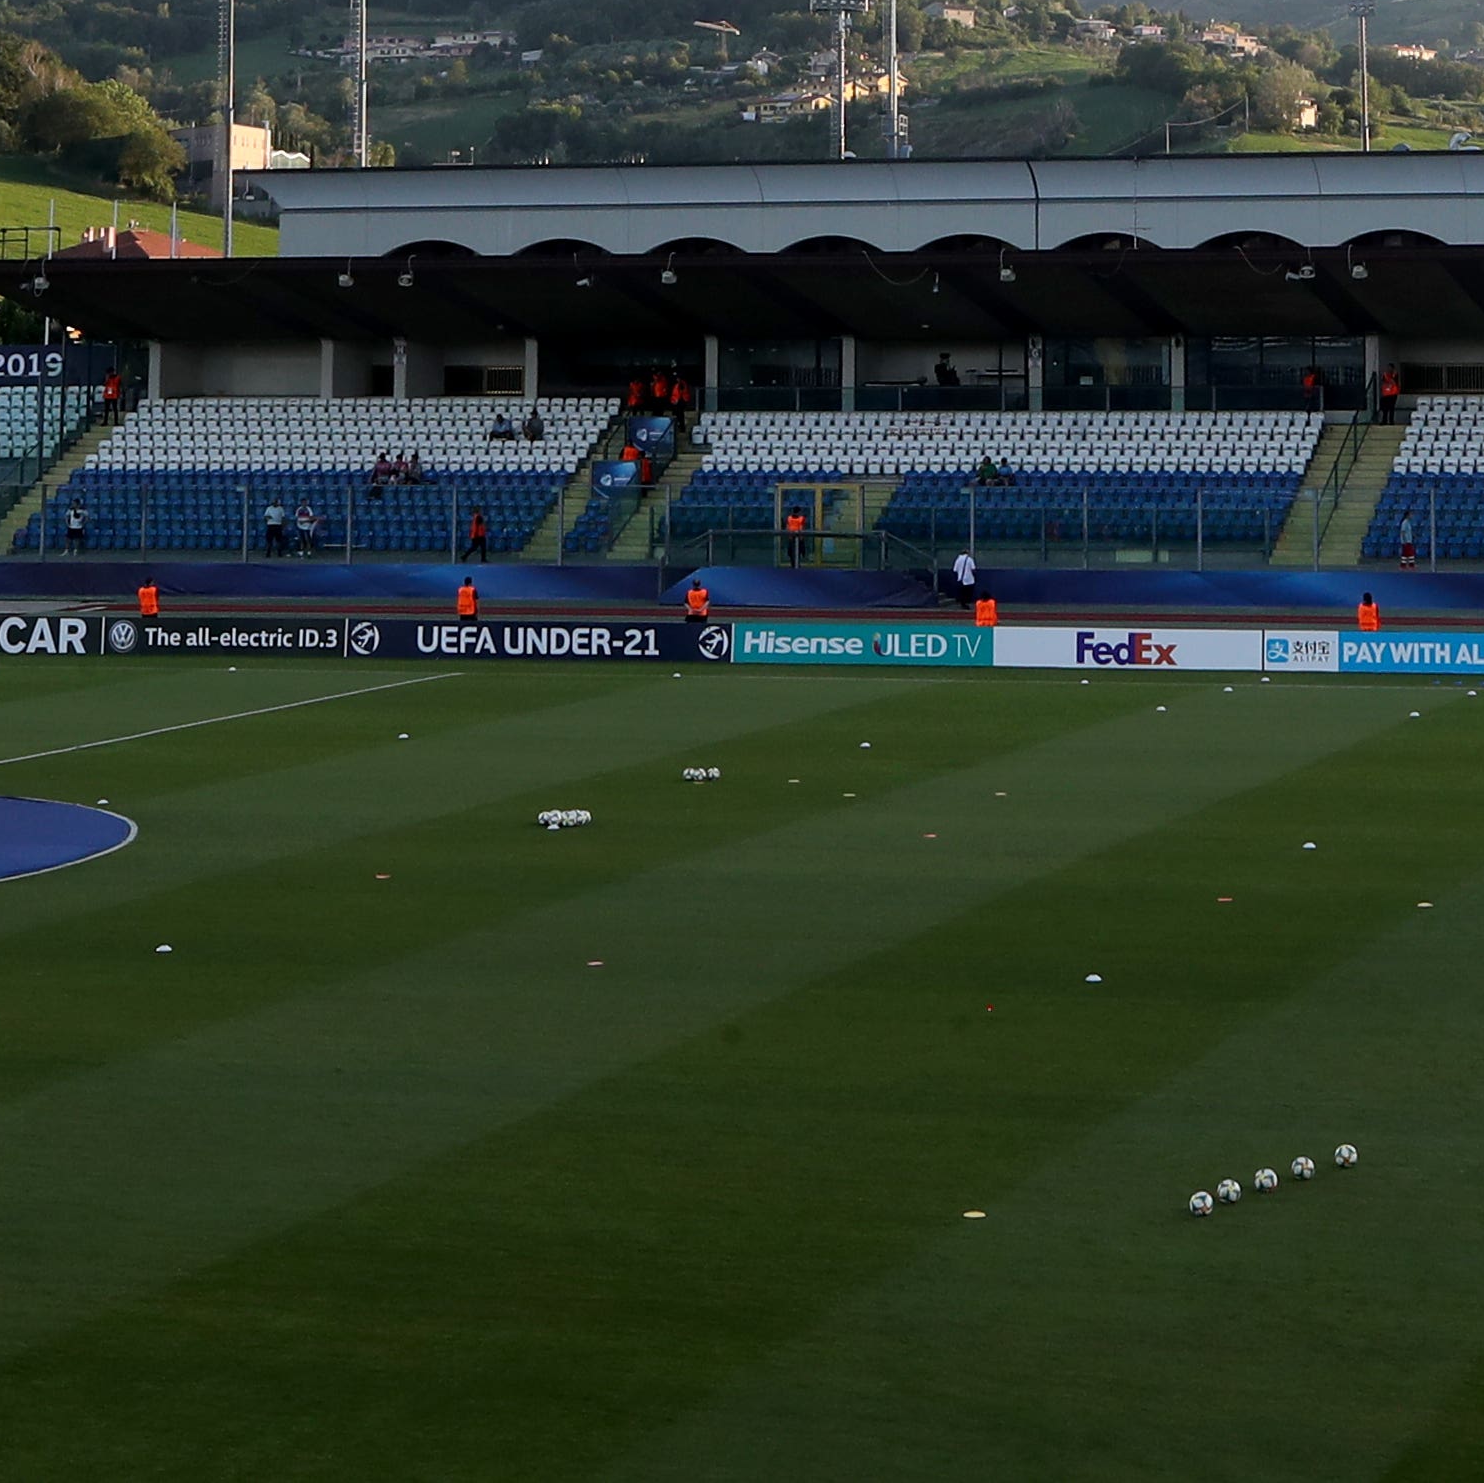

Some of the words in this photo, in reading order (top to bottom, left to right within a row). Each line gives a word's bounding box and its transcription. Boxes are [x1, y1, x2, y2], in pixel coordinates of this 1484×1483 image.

[145, 628, 182, 647] The
[185, 628, 293, 648] all-electric
[298, 628, 339, 648] ID.3
[417, 625, 497, 654] UEFA
[503, 626, 661, 656] UNDER-21
[743, 631, 864, 655] Hisense
[872, 632, 948, 658] ULED
[952, 634, 982, 658] TV
[1076, 632, 1177, 665] FedEx
[1343, 642, 1386, 663] PAY
[1389, 642, 1451, 664] WITH
